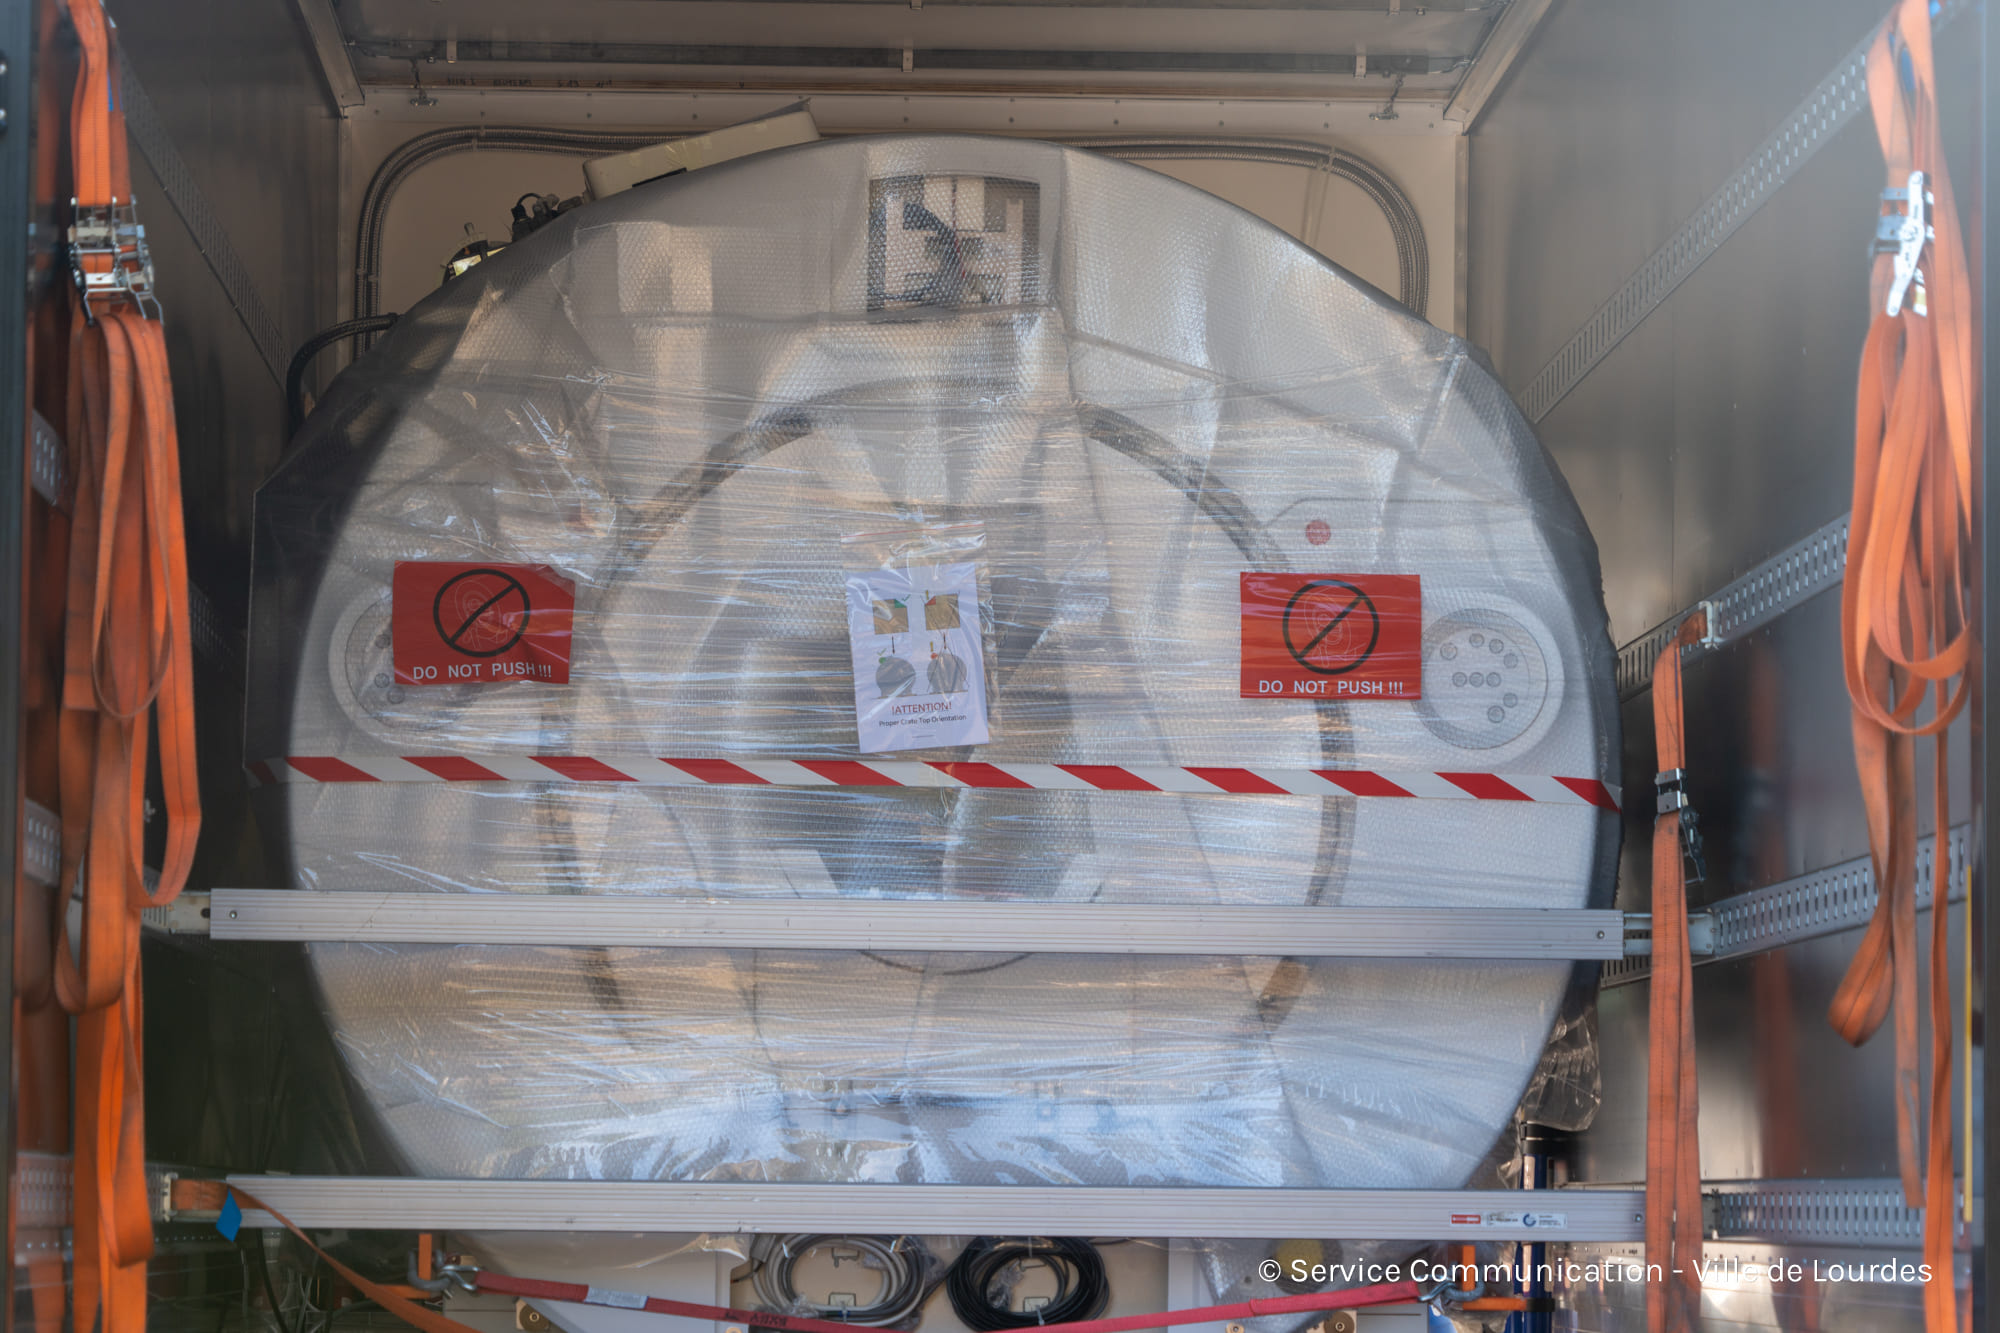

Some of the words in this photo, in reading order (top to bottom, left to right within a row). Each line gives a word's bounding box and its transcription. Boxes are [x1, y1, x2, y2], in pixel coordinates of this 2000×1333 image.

[413, 665, 438, 680] DO
[448, 663, 482, 678] NOT
[1259, 680, 1283, 693] DO
[1294, 680, 1328, 694] NOT
[1338, 680, 1383, 694] PUSH
[1388, 681, 1403, 695] !!!
[891, 701, 952, 715] !ATTENTION!
[879, 719, 899, 728] Proper
[900, 718, 918, 726] Crate
[931, 714, 967, 723] Orientation
